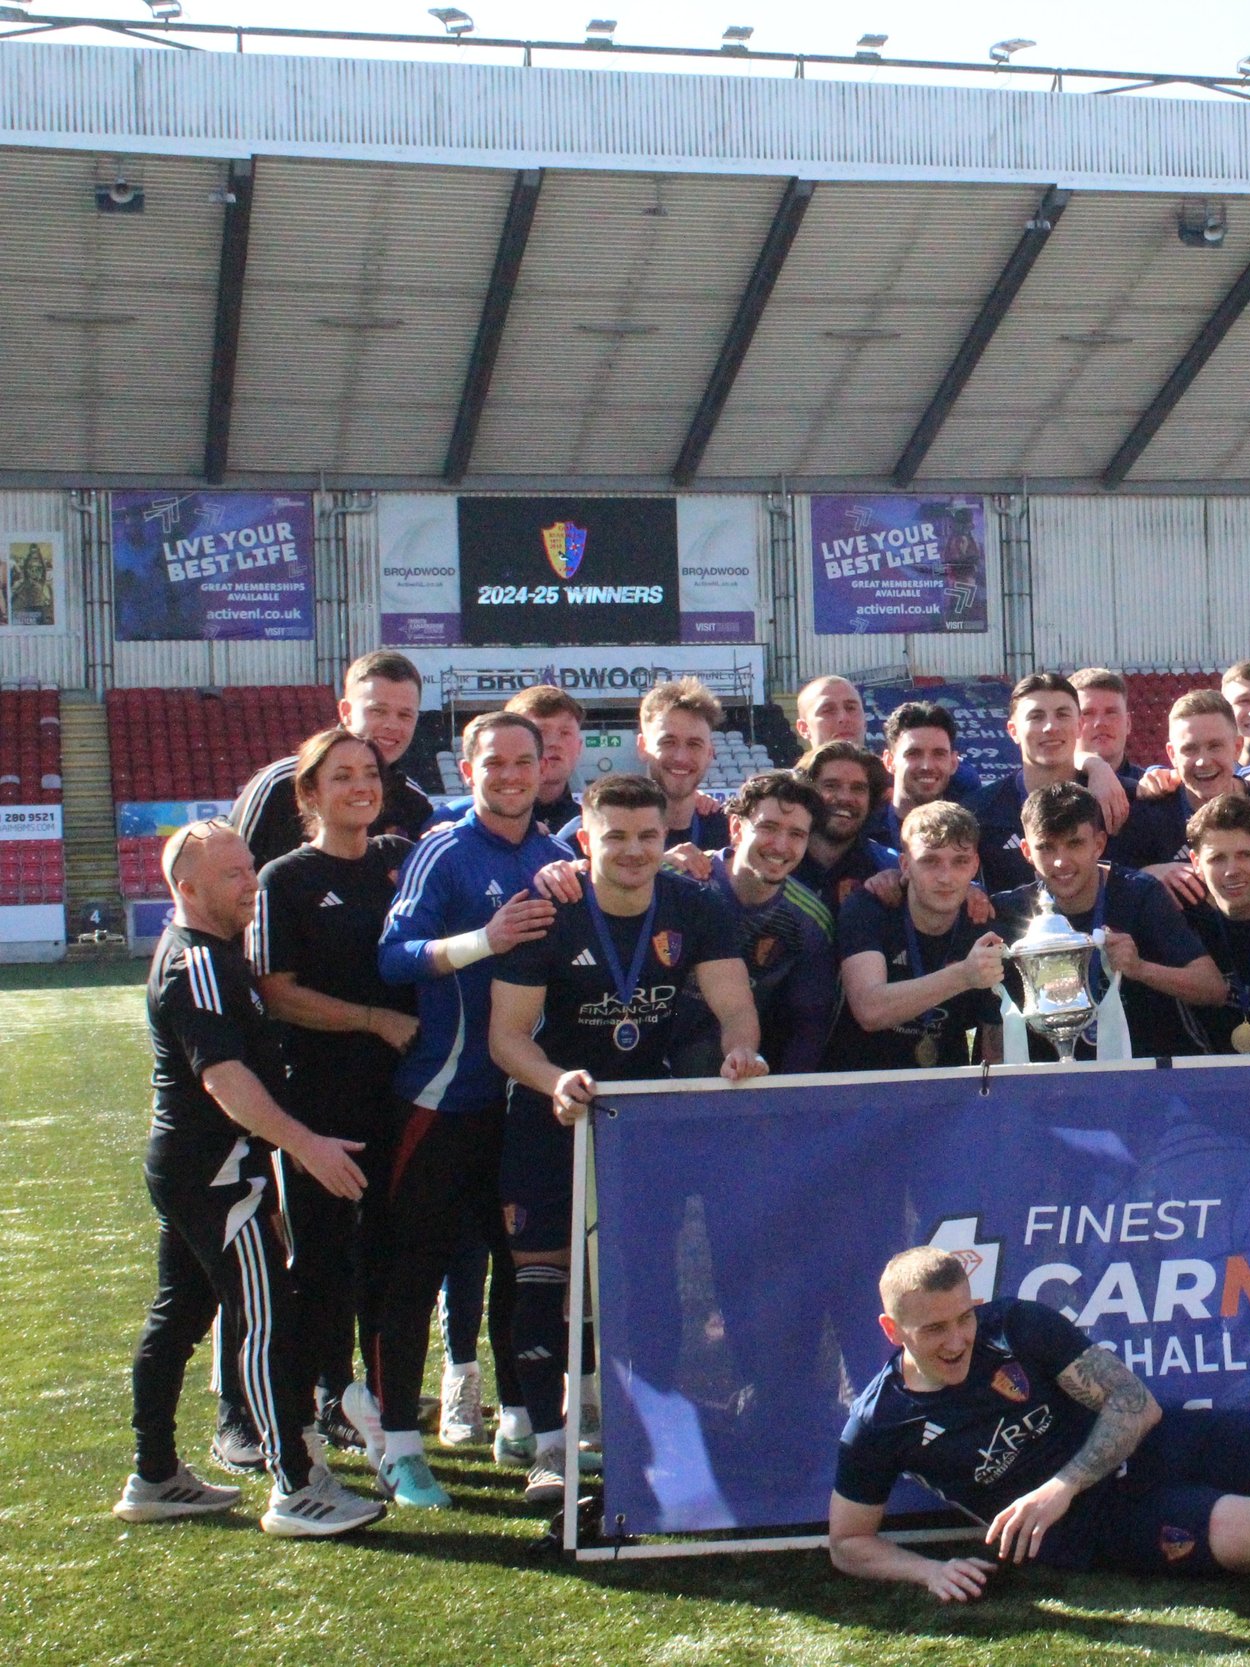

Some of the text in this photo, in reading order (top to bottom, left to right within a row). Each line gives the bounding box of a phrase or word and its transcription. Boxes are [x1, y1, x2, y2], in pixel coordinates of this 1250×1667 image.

[163, 521, 295, 561] LIVE YOUR
[821, 522, 938, 560] LIVE YOUR
[167, 543, 299, 583] BEST LIFE
[825, 542, 941, 580] BEST LIFE
[383, 567, 456, 580] BROADWOOD
[682, 567, 750, 580] BROADWOOD
[201, 582, 305, 592] GREAT MEMBERSHIPS
[851, 580, 944, 589] GREAT MEMBERSHIPS
[227, 592, 280, 602] AVAILABLE
[478, 584, 664, 605] 2024-25 WINNERS
[875, 589, 921, 598] AVAILABLE
[207, 607, 302, 620] activenl.co.uk
[856, 602, 941, 615] activenl.co.uk
[264, 627, 285, 637] VISIT
[695, 623, 716, 632] VISIT
[945, 621, 964, 630] VISIT
[5, 812, 55, 822] 280 9521
[90, 909, 101, 924] 4
[1023, 1199, 1221, 1245] FINEST
